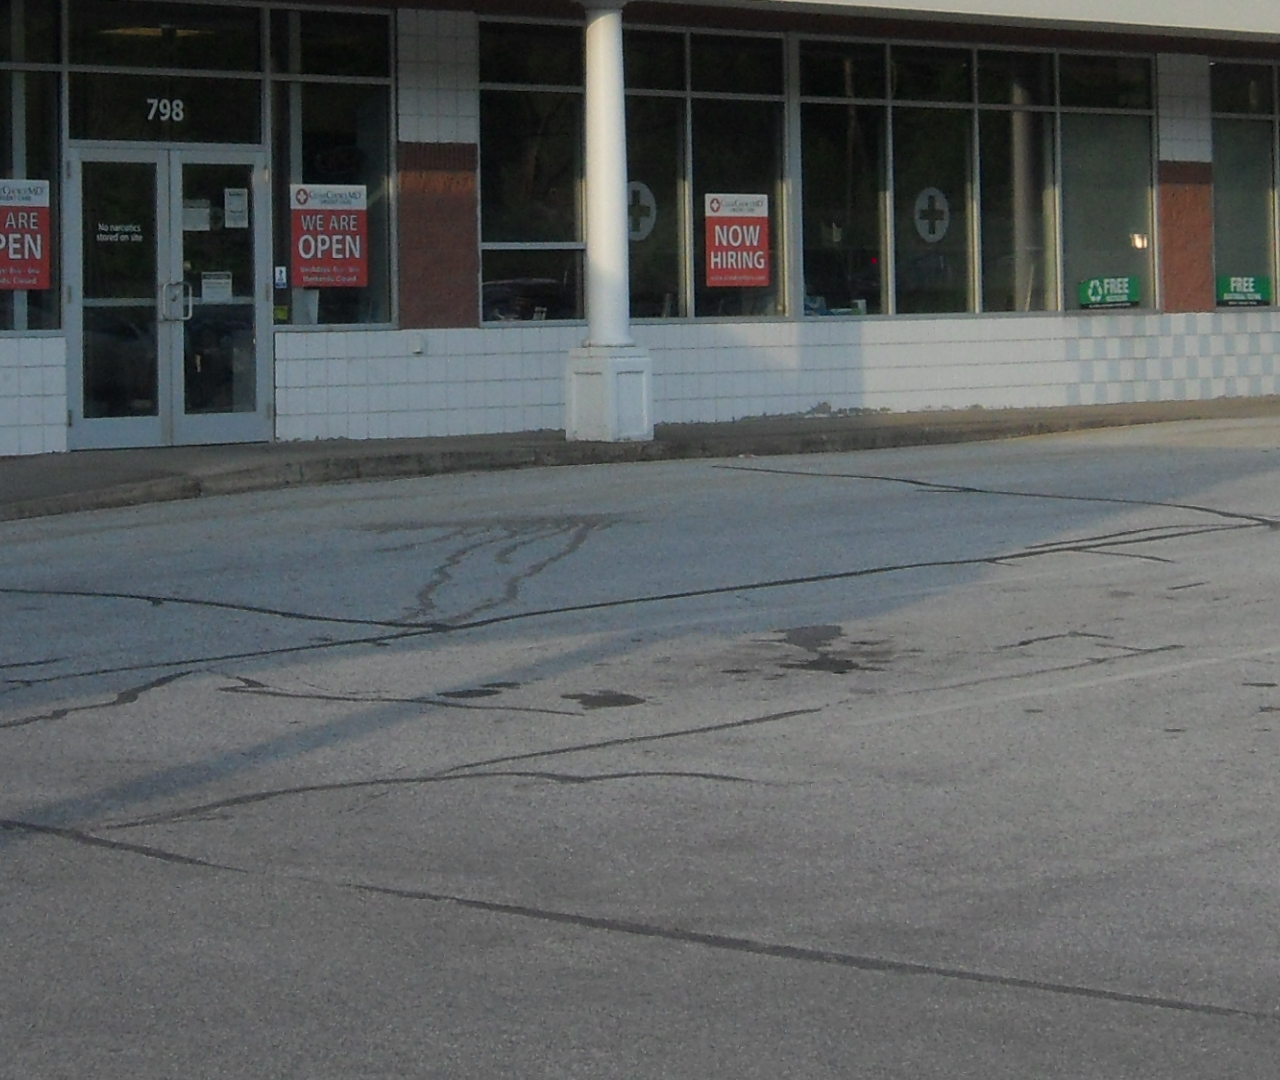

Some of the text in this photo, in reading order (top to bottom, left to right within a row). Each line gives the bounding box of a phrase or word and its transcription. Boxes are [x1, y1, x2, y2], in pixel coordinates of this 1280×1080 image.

[146, 98, 184, 121] 798
[5, 211, 39, 230] ARE
[301, 214, 358, 232] WE ARE
[714, 225, 760, 247] NOW
[298, 234, 361, 260] OPEN
[710, 251, 765, 270] HIRING
[1230, 277, 1255, 293] FREE
